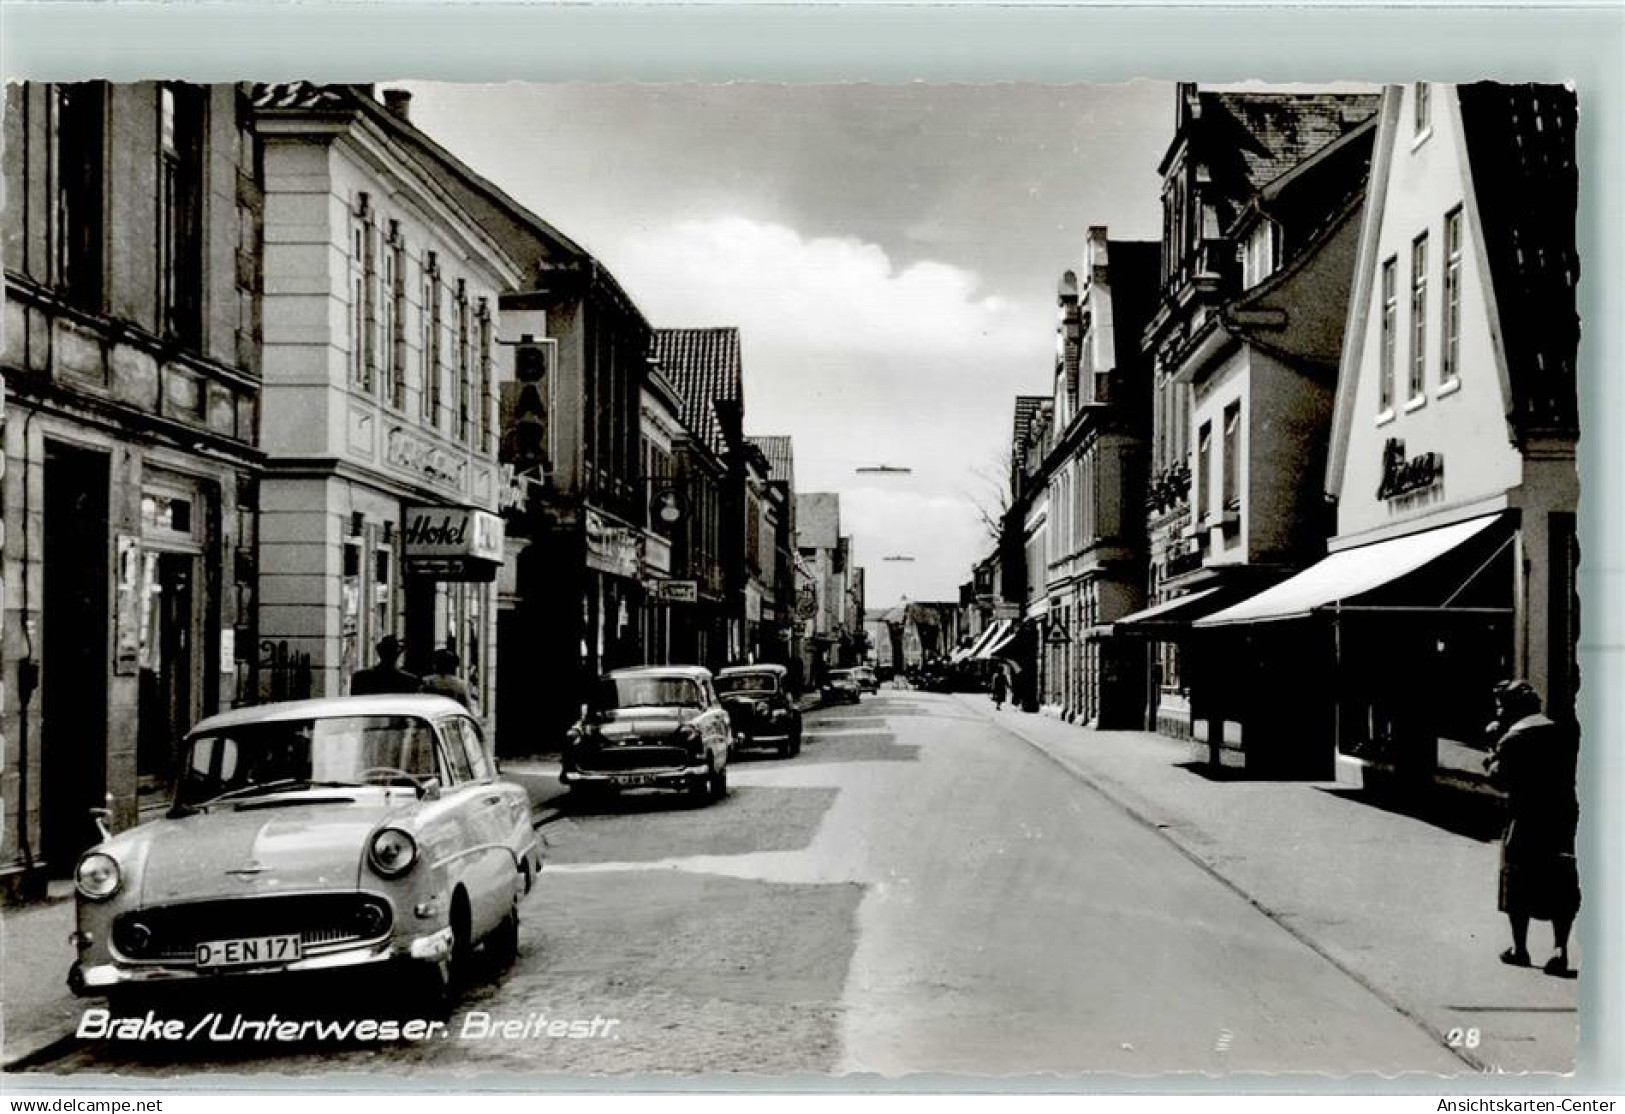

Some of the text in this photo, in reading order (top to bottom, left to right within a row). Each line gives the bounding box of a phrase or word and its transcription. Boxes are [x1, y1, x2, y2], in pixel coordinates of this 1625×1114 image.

[406, 515, 469, 545] Hotel
[198, 938, 299, 964] D-EN 171
